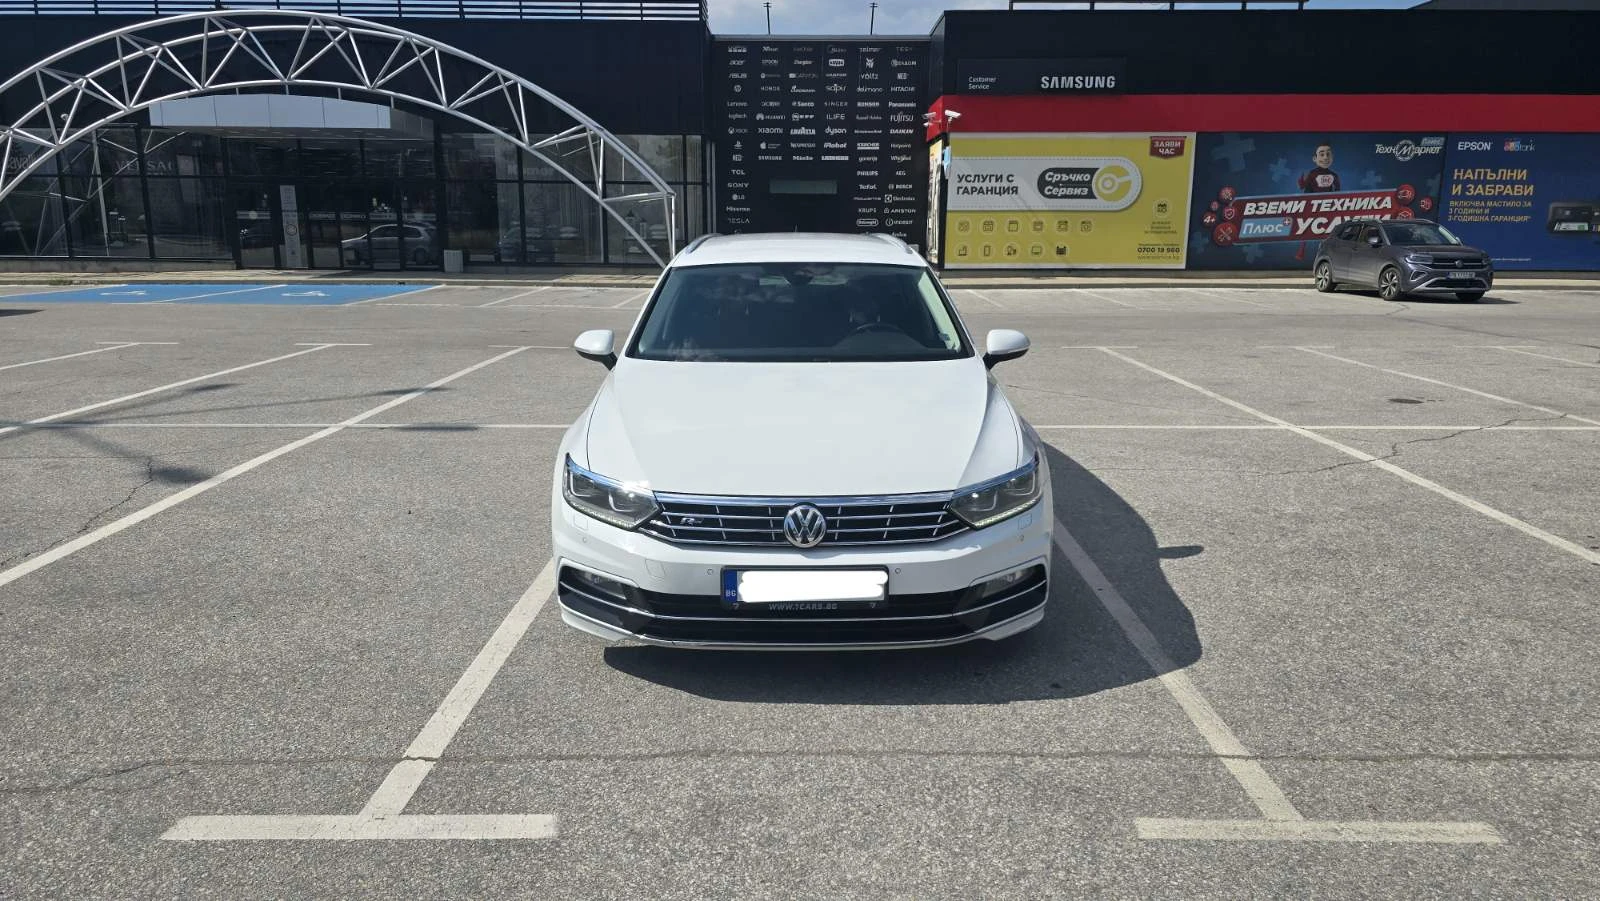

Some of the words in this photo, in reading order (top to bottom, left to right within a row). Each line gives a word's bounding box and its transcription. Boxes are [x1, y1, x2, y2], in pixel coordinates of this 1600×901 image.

[1041, 76, 1116, 89] SAMSUNG
[890, 112, 913, 122] FUJITSU
[825, 127, 847, 135] dyson
[1458, 141, 1491, 151] EPSON
[957, 174, 1003, 183] УСЛУГИ
[1006, 174, 1015, 183] С
[1044, 172, 1091, 184] Сръчко
[1453, 169, 1527, 180] НАПЪЛНИ
[956, 186, 1019, 196] ГАРАНЦИЯ
[1044, 186, 1089, 197] Сервиз
[1451, 184, 1461, 196] И
[1465, 184, 1534, 196] ЗАБРАВИ
[1243, 201, 1305, 216] ВЗЕМИ
[1310, 196, 1392, 213] ТЕХНИКА
[1486, 200, 1522, 208] МАСТИЛО
[1242, 223, 1284, 235] Плюс
